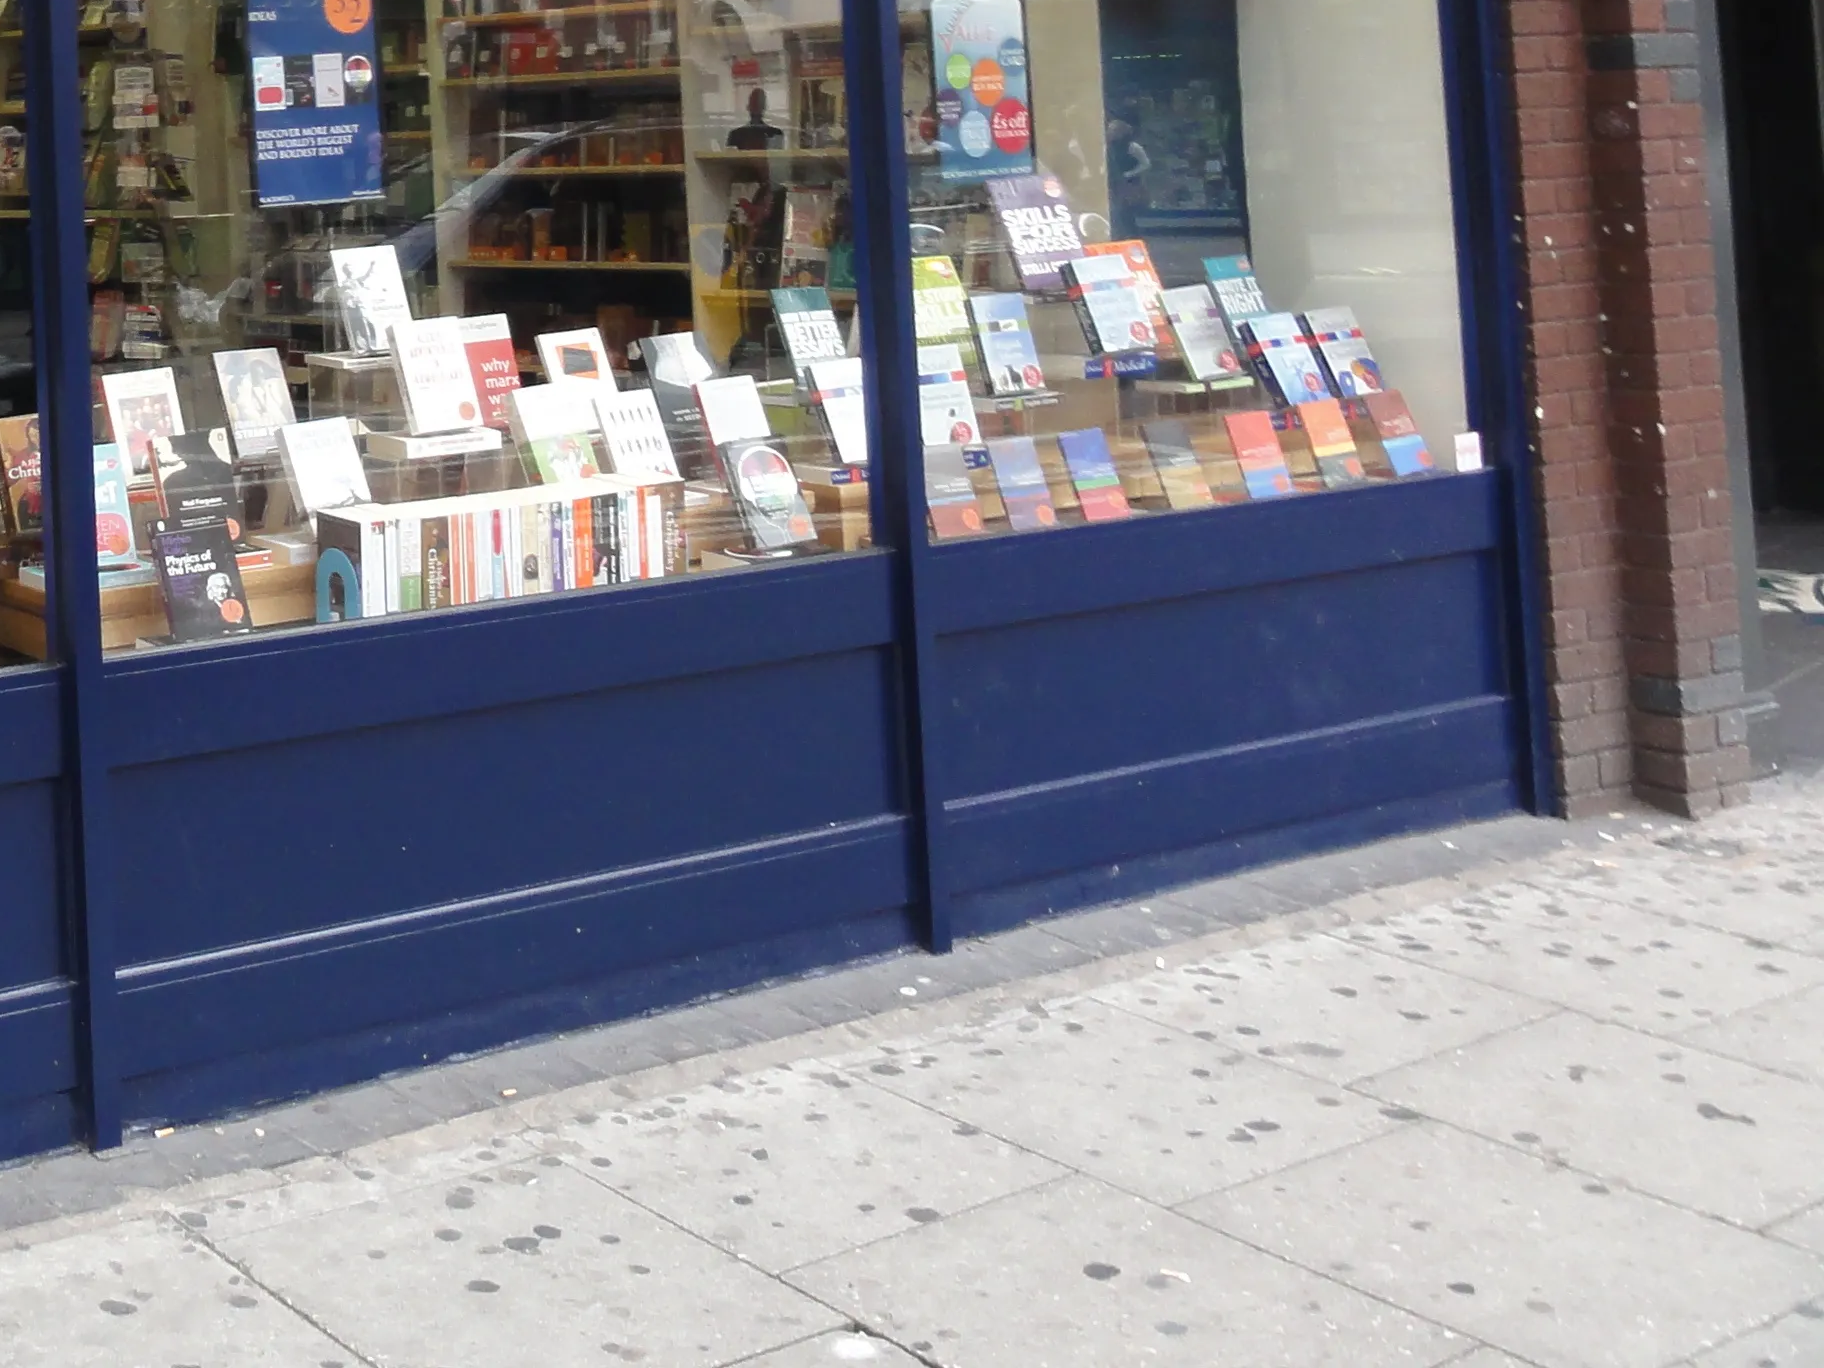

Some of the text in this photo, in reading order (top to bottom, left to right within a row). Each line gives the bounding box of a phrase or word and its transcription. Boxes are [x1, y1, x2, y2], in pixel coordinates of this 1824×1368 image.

[256, 124, 360, 140] DISCOVER MORE ABOUT
[257, 140, 275, 150] THE
[317, 135, 353, 145] BIGGEST
[258, 150, 278, 160] AND
[319, 146, 345, 157] IDEAS
[1001, 204, 1072, 229] SKILLS
[1008, 222, 1079, 243] FOR
[1012, 236, 1082, 256] SUCCESS
[1220, 294, 1267, 315] RIGHT
[481, 357, 511, 374] why
[485, 374, 521, 389] marx
[164, 548, 213, 569] Physics of
[167, 561, 217, 577] the Future
